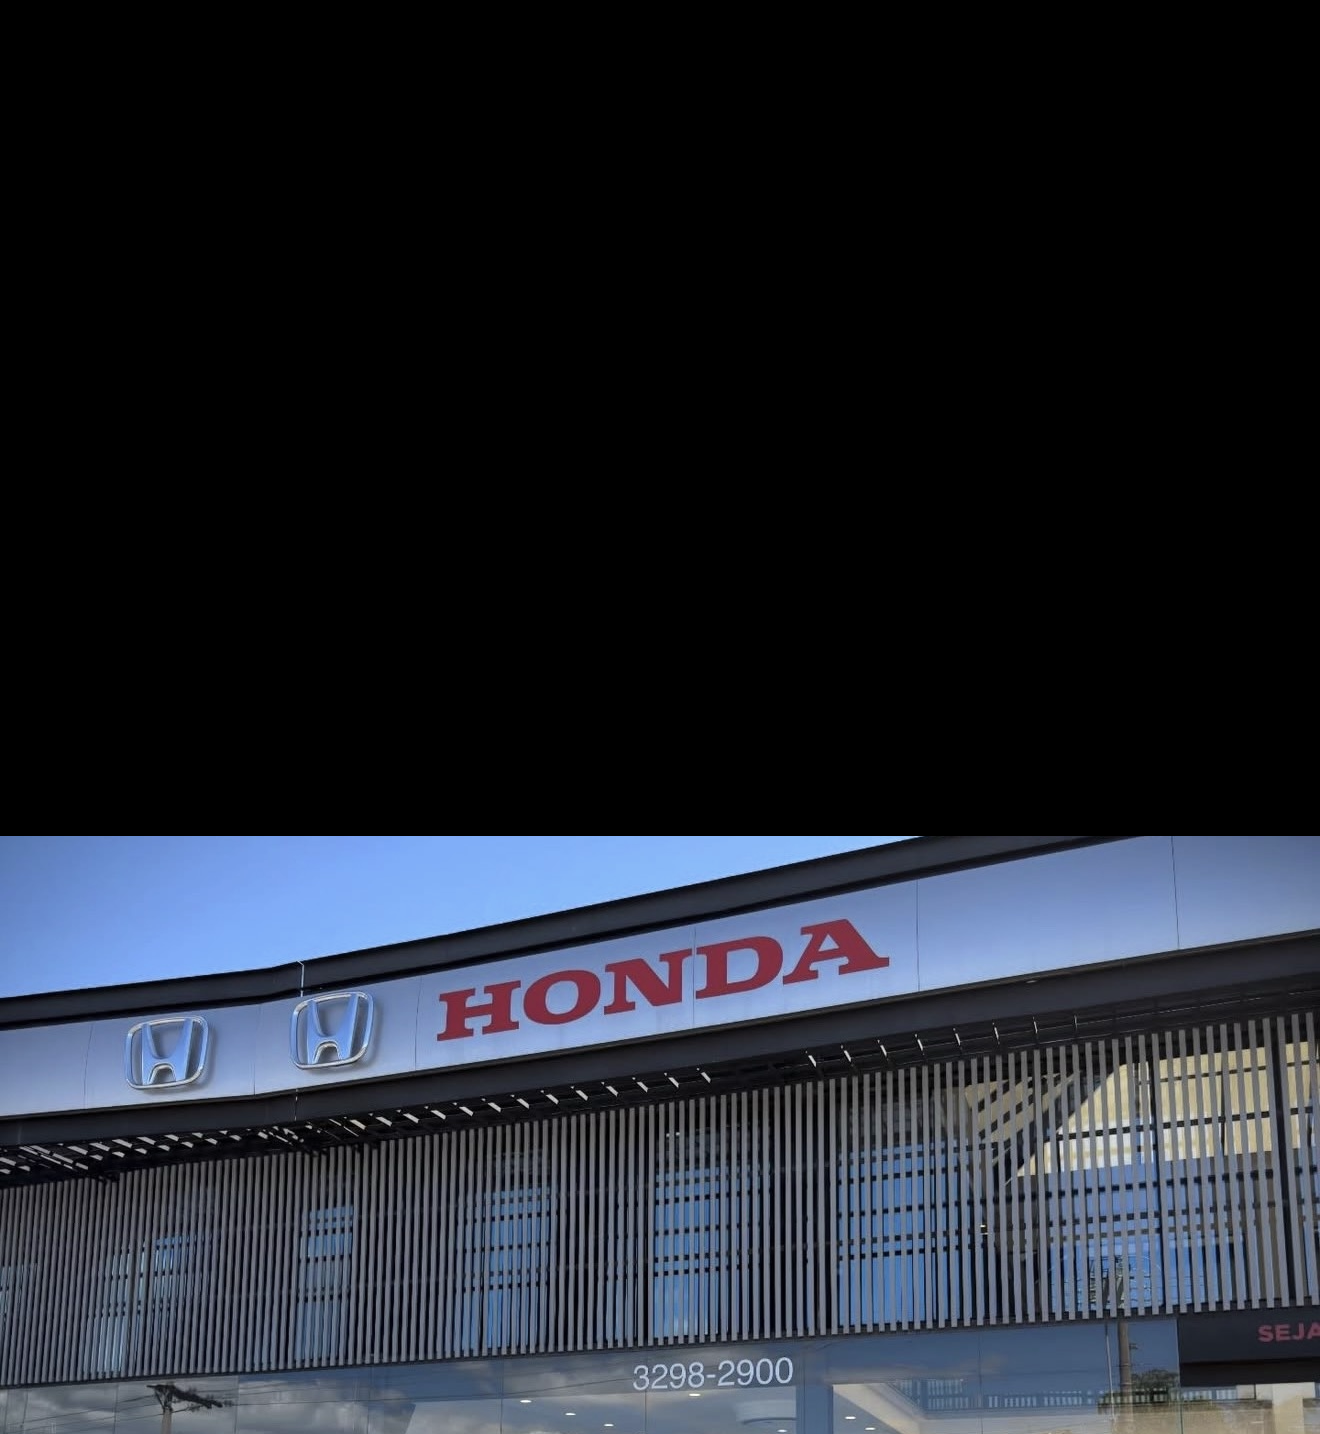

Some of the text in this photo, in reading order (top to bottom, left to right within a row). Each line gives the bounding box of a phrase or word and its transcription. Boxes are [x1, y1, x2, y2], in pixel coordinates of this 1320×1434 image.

[436, 918, 890, 1042] HONDA
[1258, 1322, 1320, 1343] SEJA
[632, 1356, 794, 1391] 3298-2900
